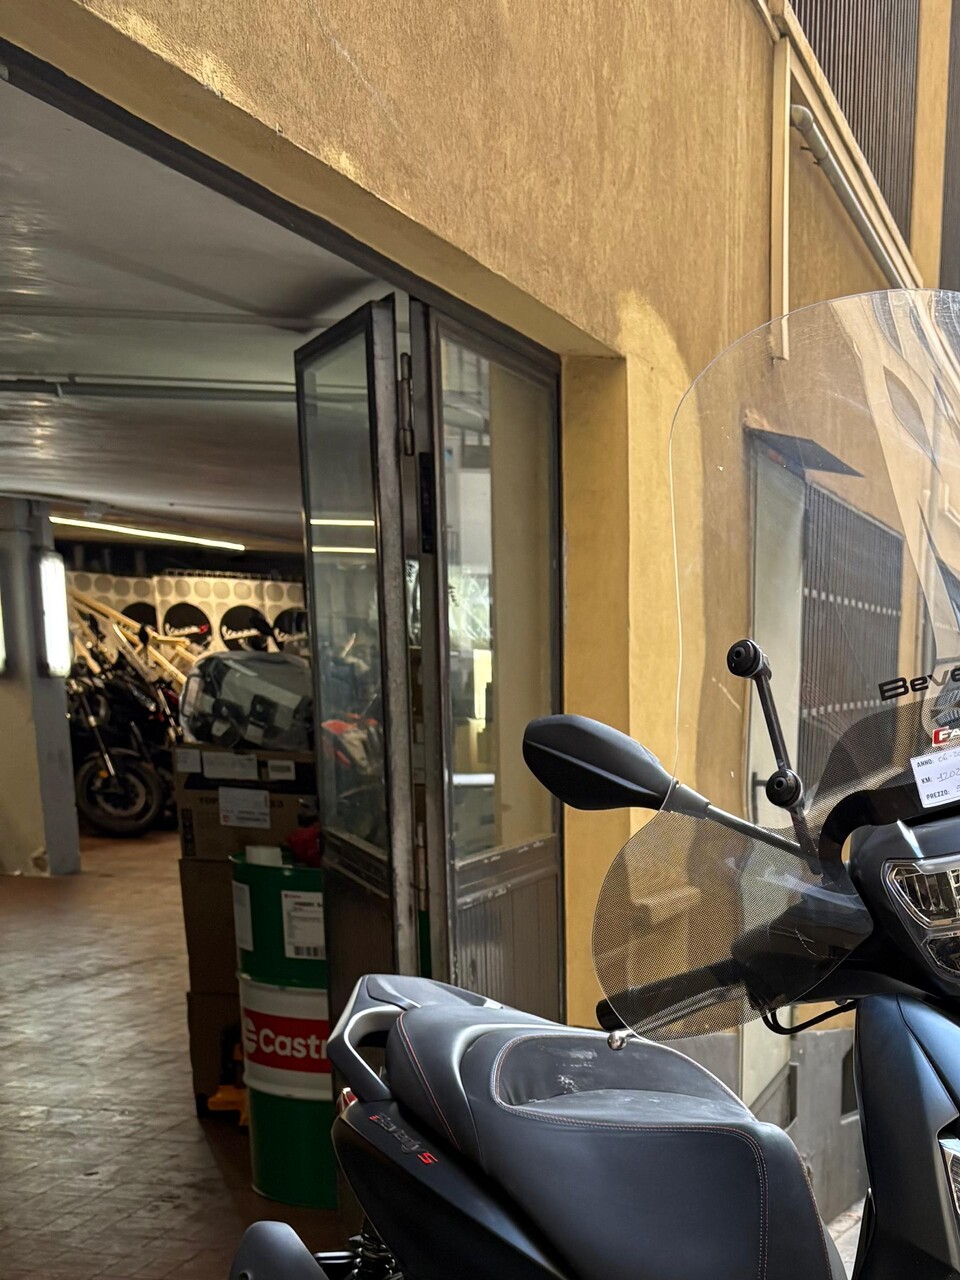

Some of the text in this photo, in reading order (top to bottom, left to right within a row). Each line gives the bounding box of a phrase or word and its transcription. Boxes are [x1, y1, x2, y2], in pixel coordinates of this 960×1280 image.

[916, 758, 935, 768] ANNO:
[920, 776, 933, 785] KM:
[925, 789, 951, 800] PREZZO:
[258, 1027, 329, 1060] Cast
